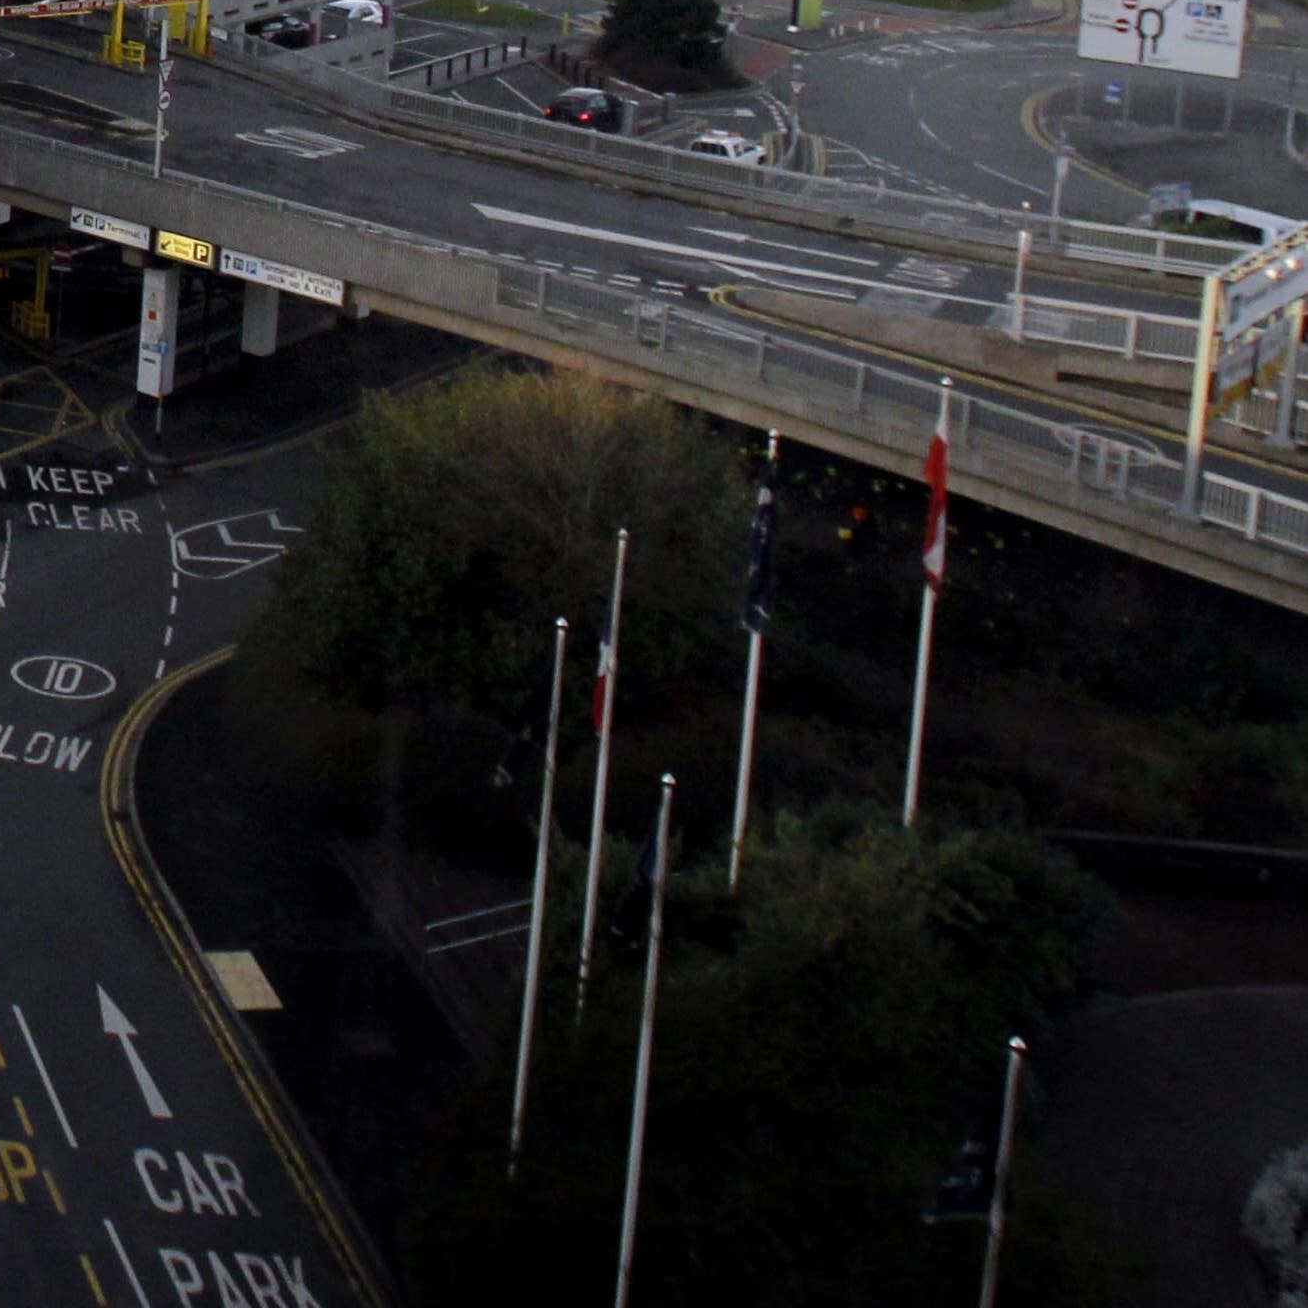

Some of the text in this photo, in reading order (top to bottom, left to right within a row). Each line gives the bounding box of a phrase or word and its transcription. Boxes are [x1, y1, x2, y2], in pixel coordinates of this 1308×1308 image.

[107, 223, 142, 240] Terminal
[197, 245, 207, 259] P
[27, 465, 114, 494] KEEP
[27, 502, 142, 534] CLEAR
[44, 660, 83, 693] 10
[133, 1148, 261, 1217] CAR
[158, 1249, 324, 1308] PARK
